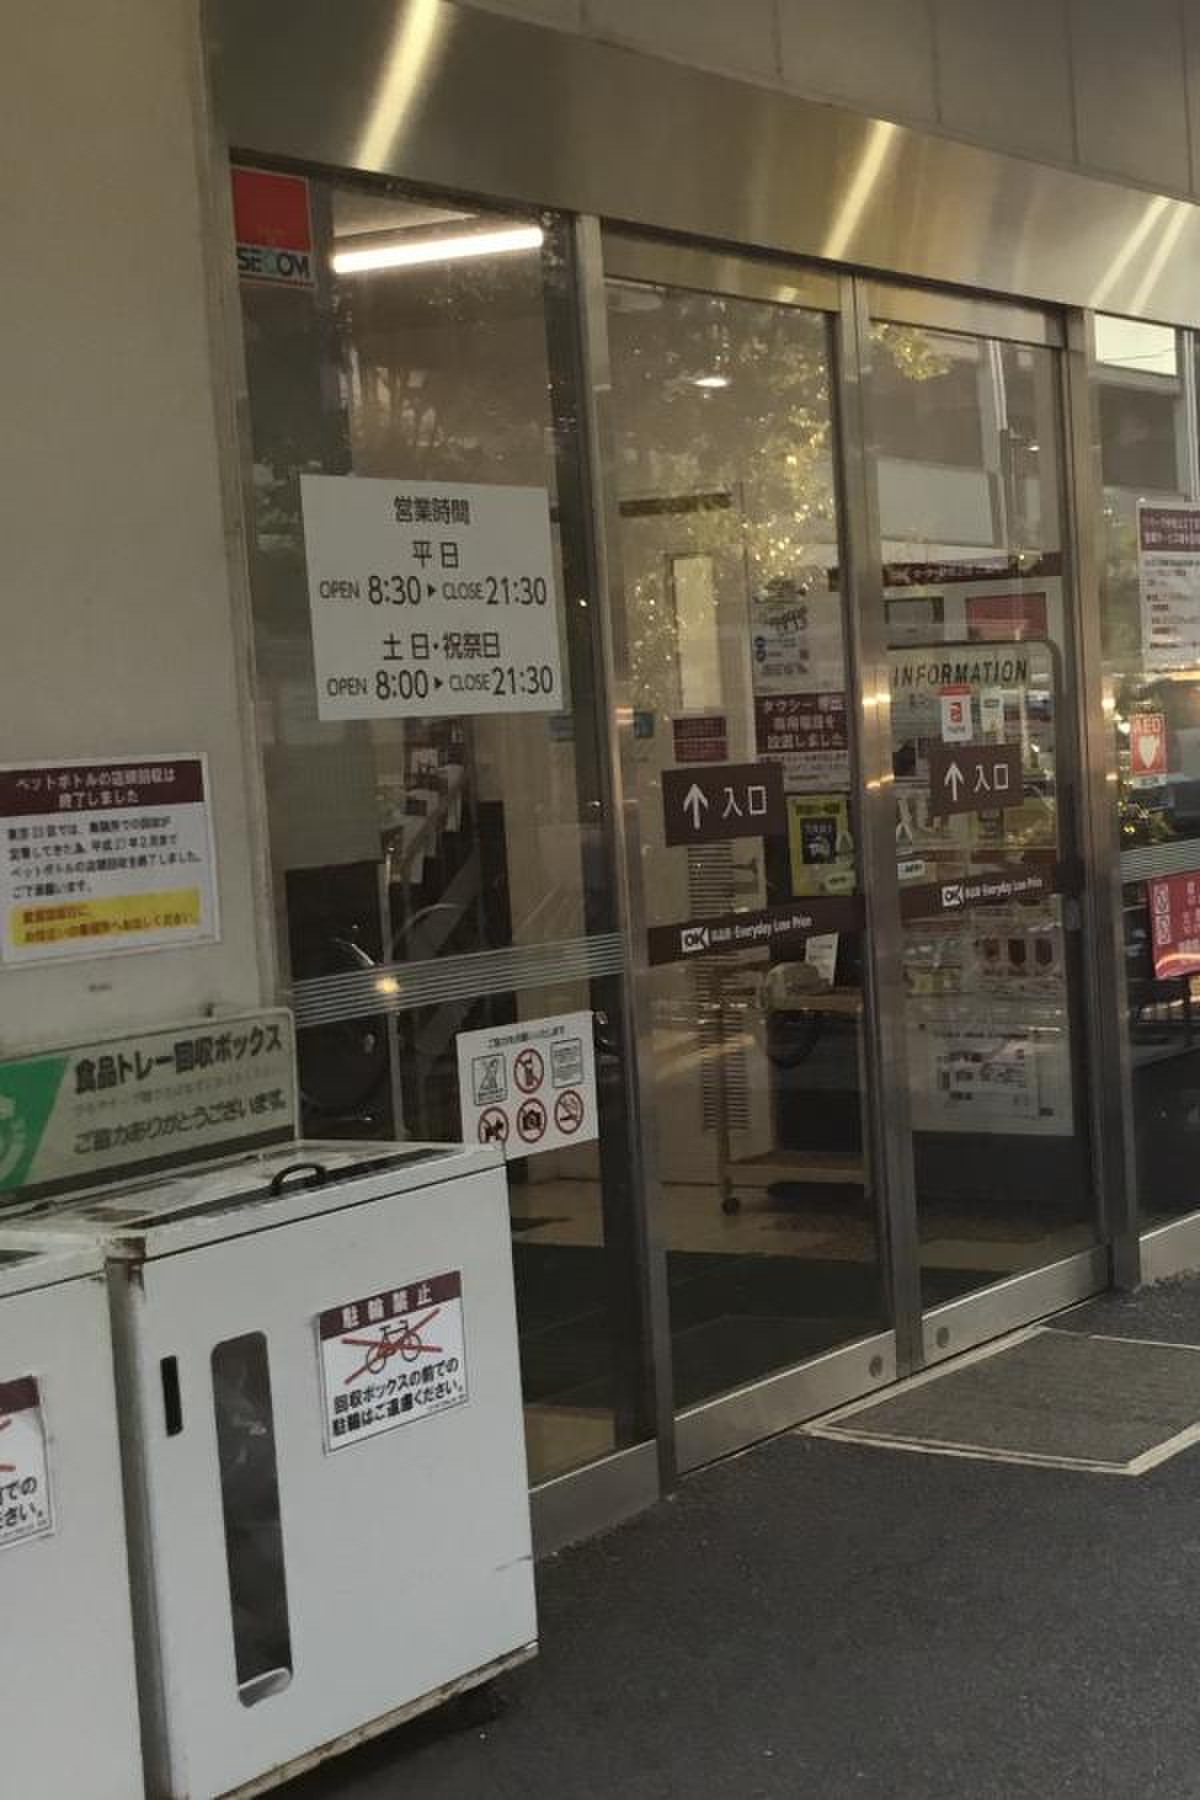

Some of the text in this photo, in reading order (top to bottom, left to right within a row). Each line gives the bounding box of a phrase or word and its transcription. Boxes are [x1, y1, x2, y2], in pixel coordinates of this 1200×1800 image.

[236, 245, 310, 279] SEOM
[393, 495, 471, 525] 営業時間
[411, 540, 459, 569] 平日
[319, 575, 547, 605] OPEN 8:30 CLOSE 21:30
[326, 664, 553, 700] OPEN 8:00 CLOSE 21:30
[894, 659, 1027, 687] INFORMATION
[1131, 717, 1161, 736] AED
[974, 763, 1010, 793] 入口
[722, 785, 768, 819] 入口
[681, 927, 711, 952] OK
[74, 1023, 283, 1096] 食品トレー回収ボックス
[333, 1357, 459, 1415] 回収ボックスの前での
